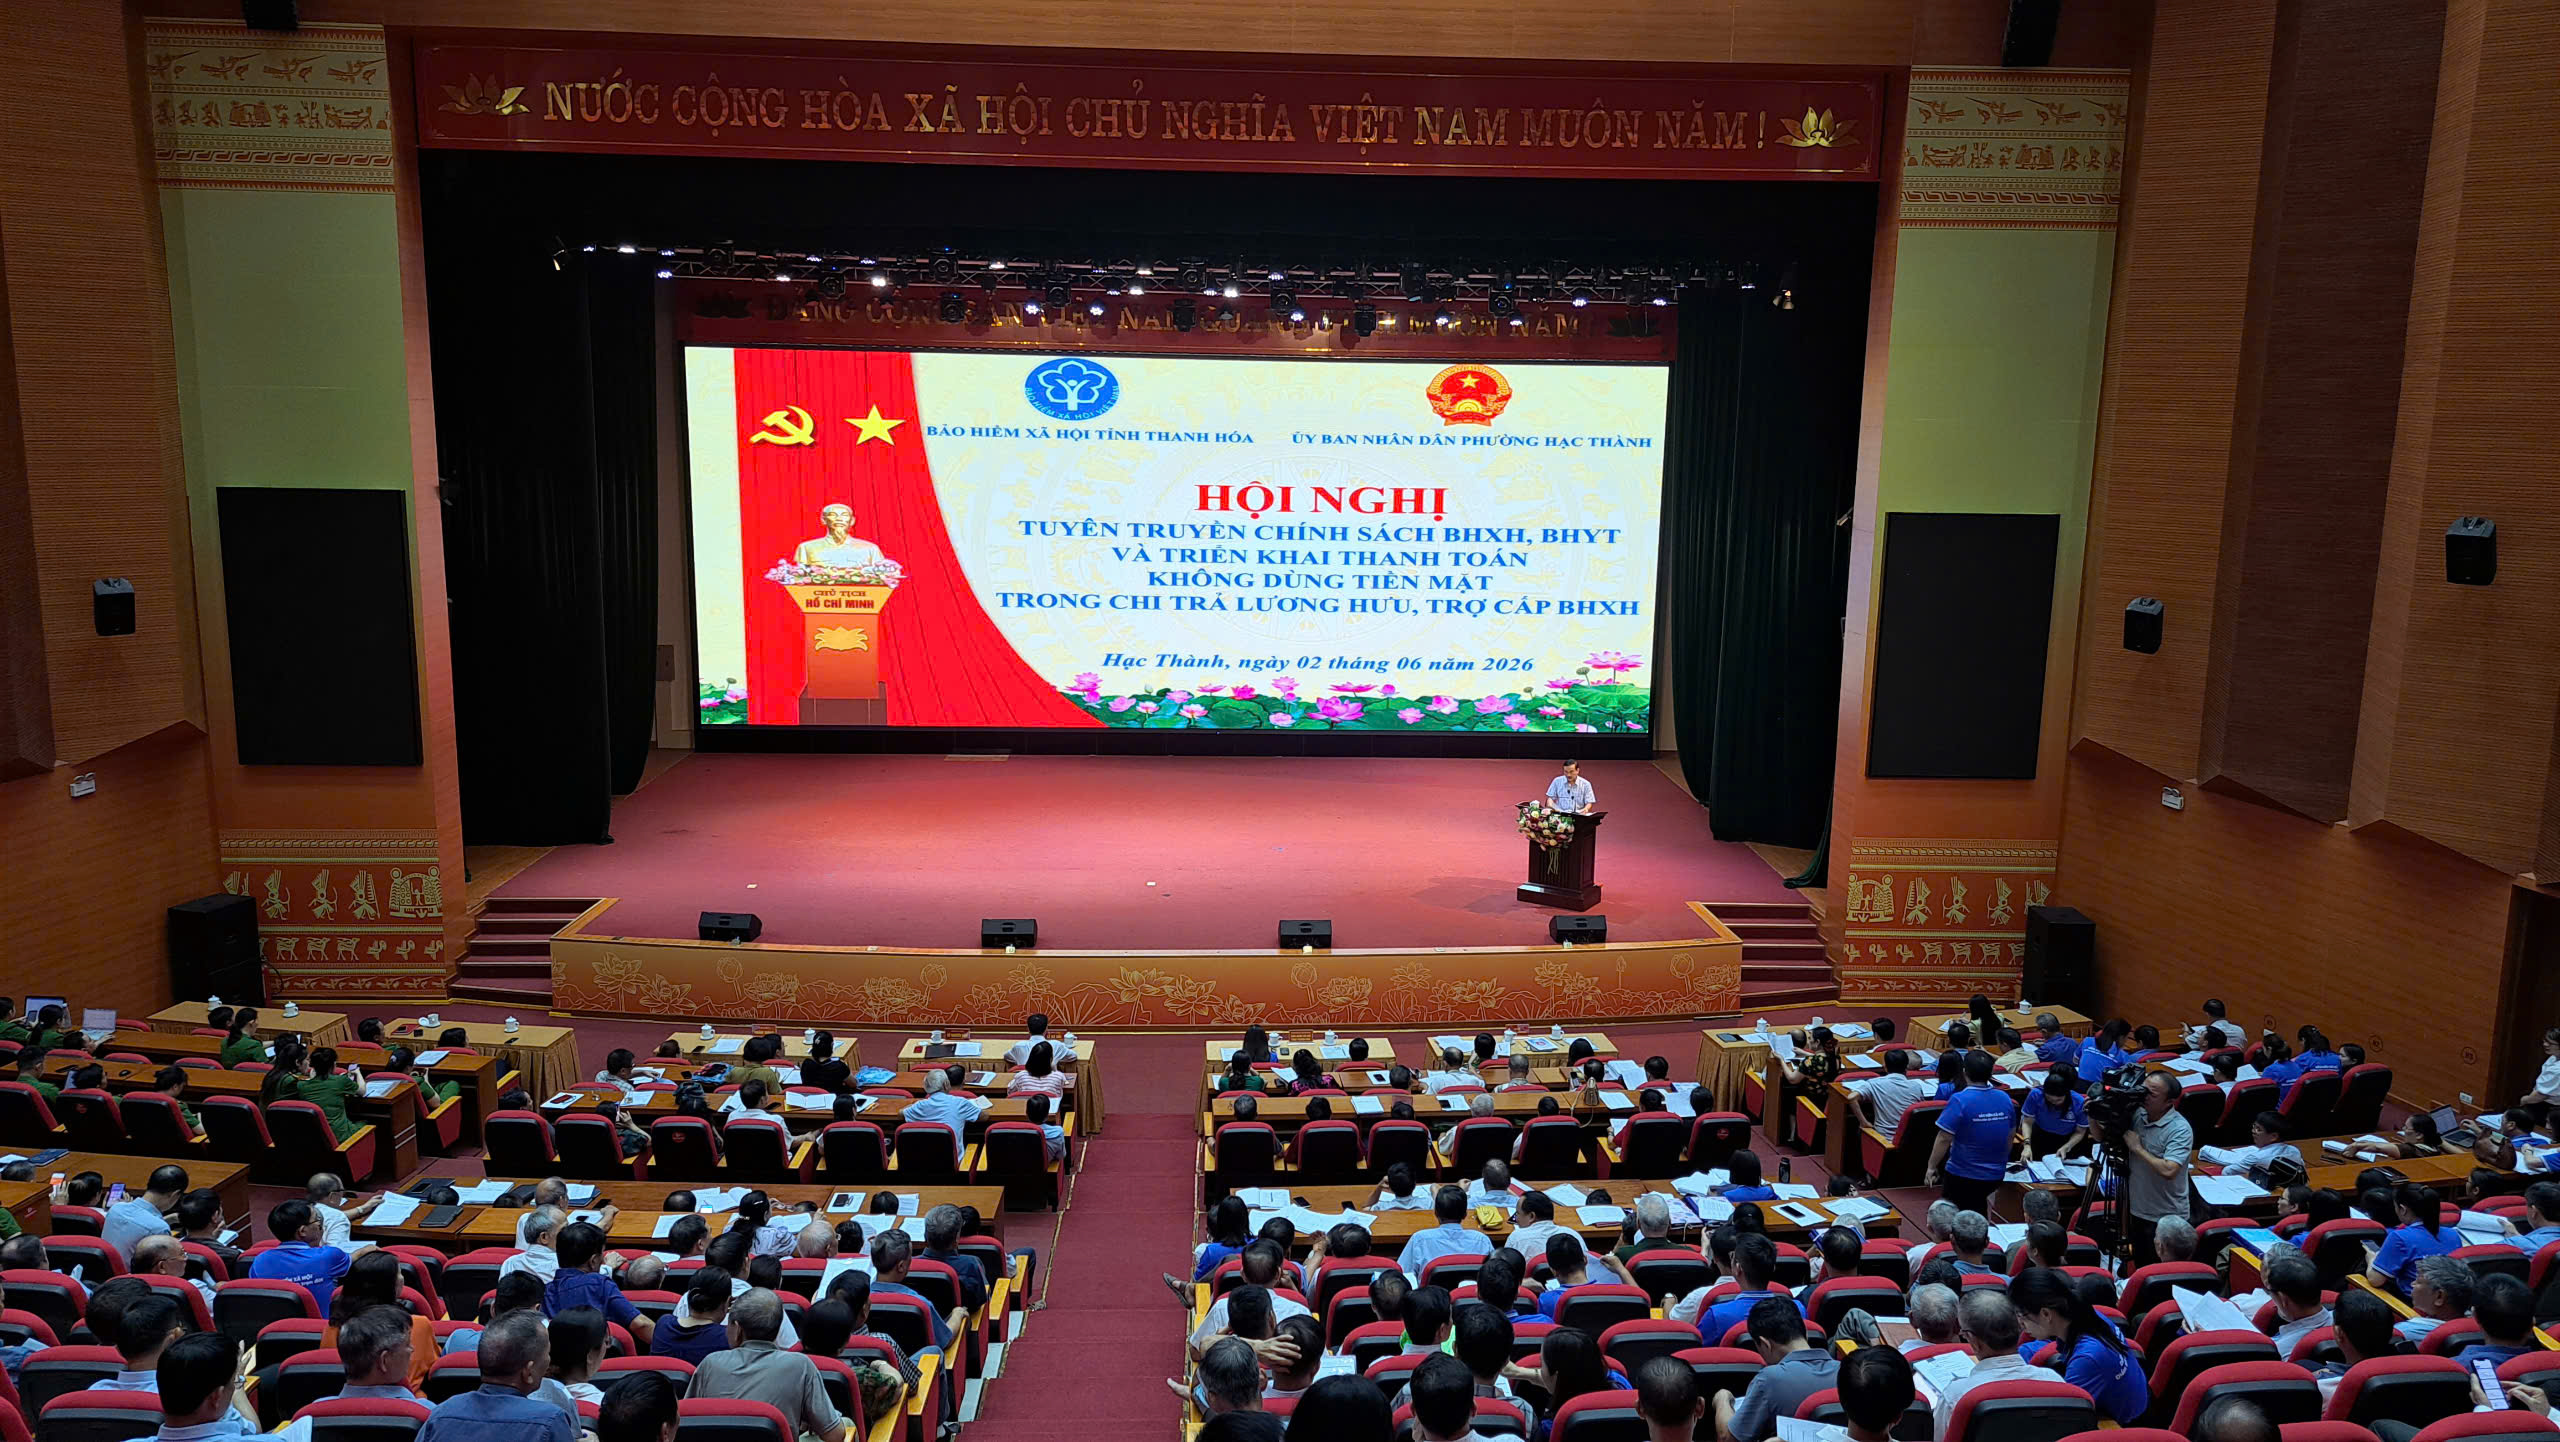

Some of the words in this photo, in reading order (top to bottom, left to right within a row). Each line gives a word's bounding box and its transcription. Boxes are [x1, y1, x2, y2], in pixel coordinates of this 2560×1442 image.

[542, 67, 659, 124] NƯỚC
[672, 72, 790, 137] CỘNG
[800, 76, 892, 131] HÒA
[903, 84, 966, 133] XÃ
[976, 82, 1053, 145] HỘI
[1066, 79, 1150, 139] CHỦ
[1162, 93, 1296, 142] NGHĨA
[1309, 92, 1403, 155] VIỆT
[1413, 106, 1510, 146] NAM
[1519, 97, 1644, 148] MUÔN
[927, 424, 966, 437] BẢO
[971, 425, 1020, 438] HIỂM
[1025, 426, 1051, 439] XÃ
[1056, 428, 1090, 441] HỘI
[1145, 431, 1209, 443] THANH
[1215, 430, 1254, 443] HÓA
[1321, 435, 1358, 445] BAN
[1363, 433, 1414, 446] NHÂN
[1419, 433, 1456, 446] DÂN
[1461, 434, 1539, 447] PHƯỜNG
[1545, 436, 1582, 449] HẠC
[1588, 434, 1652, 448] THÀNH
[1194, 481, 1296, 520] HỘI
[1309, 486, 1448, 522] NGHỊ
[1018, 517, 1119, 537] TUYÊN
[1127, 520, 1246, 540] TRUYỀN
[1254, 522, 1350, 542] CHÍNH
[1357, 522, 1436, 543] SÁCH
[1443, 528, 1533, 545] BHXH,
[1541, 528, 1621, 544] BHYT
[1111, 543, 1152, 562] VÀ
[1159, 544, 1249, 564] TRIỂN
[1256, 549, 1330, 565] KHAI
[1338, 551, 1440, 567] THANH
[1447, 548, 1528, 567] TOÁN
[1147, 568, 1255, 588] KHÔNG
[1263, 570, 1345, 589] DÙNG
[1351, 571, 1420, 590] TIỀN
[1428, 572, 1494, 594] MẶT
[845, 599, 874, 608] MINH
[995, 592, 1101, 609] TRONG
[1108, 594, 1161, 610] CHI
[1169, 592, 1228, 611] TRẢ
[1236, 595, 1340, 613] LƯƠNG
[1349, 597, 1419, 617] HƯU,
[1425, 598, 1488, 618] TRỢ
[1494, 596, 1551, 615] CẤP
[1557, 600, 1640, 616] BHXH
[1101, 653, 1148, 671] Hạc
[1155, 654, 1231, 670] Thành,
[1238, 655, 1291, 673] ngày
[1296, 655, 1323, 670] 02
[1328, 655, 1390, 674] tháng
[1396, 656, 1422, 671] 06
[1428, 657, 1476, 671] năm
[1483, 657, 1534, 672] 2026
